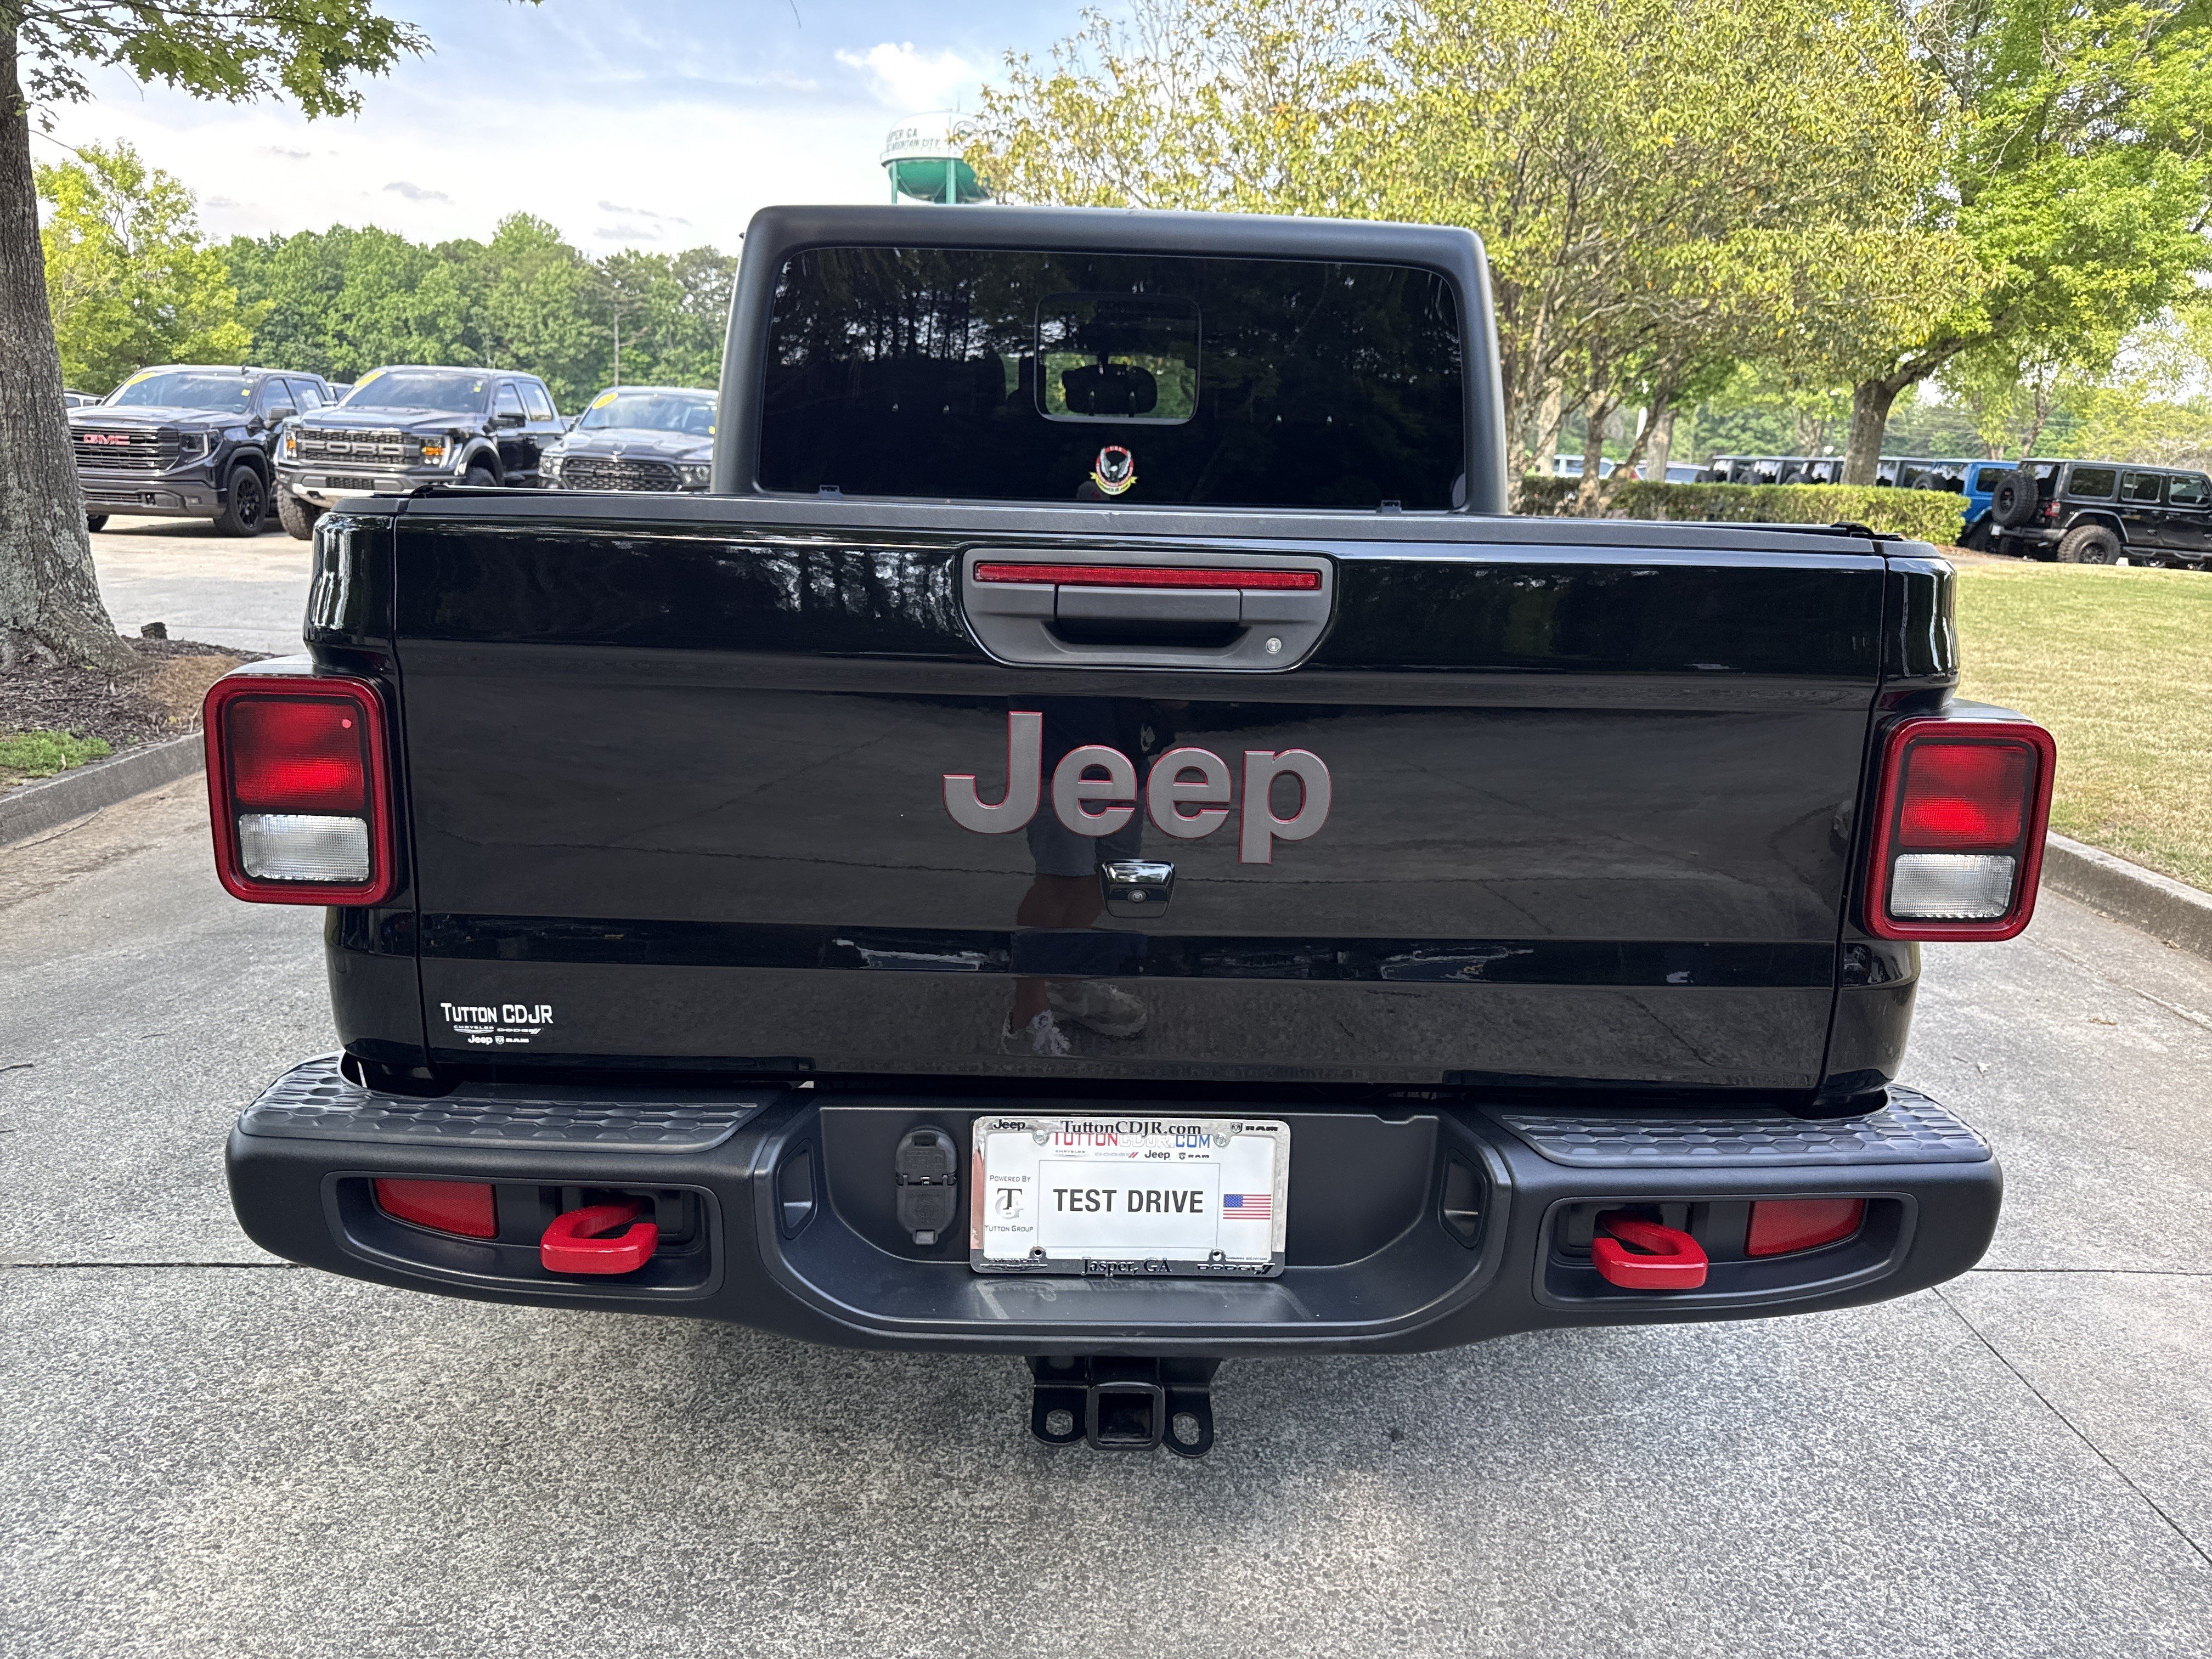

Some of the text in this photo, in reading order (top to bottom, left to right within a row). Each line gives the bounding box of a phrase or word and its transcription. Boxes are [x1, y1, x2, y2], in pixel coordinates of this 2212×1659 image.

[906, 127, 917, 138] GA
[922, 138, 940, 147] CITY
[83, 433, 130, 445] GMC
[301, 439, 406, 456] FORD
[943, 711, 1332, 865] Jeep
[503, 1004, 554, 1024] CDJR
[467, 1035, 493, 1045] Jeep
[994, 1119, 1025, 1131] Jeep
[1061, 1120, 1201, 1137] TuttonCDJR.com
[1144, 1150, 1170, 1159] Jeep
[1053, 1189, 1203, 1213] TEST DRIVE
[1081, 1257, 1138, 1277] Jasper,
[1143, 1257, 1172, 1272] GA
